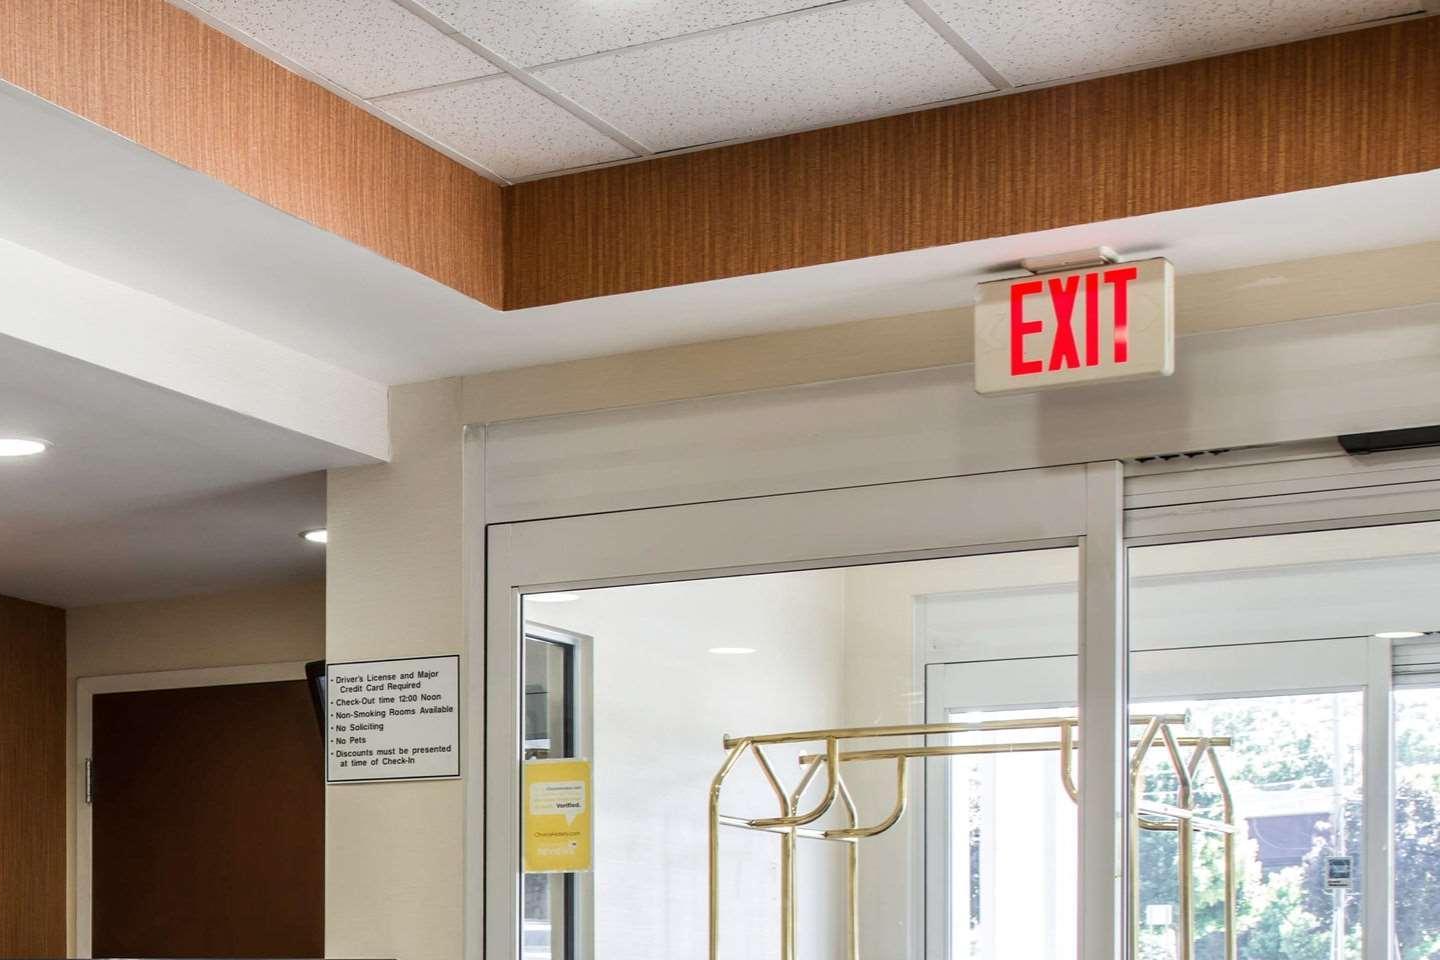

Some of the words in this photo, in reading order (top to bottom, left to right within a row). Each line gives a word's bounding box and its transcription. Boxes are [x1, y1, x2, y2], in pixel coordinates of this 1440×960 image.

[1010, 266, 1138, 377] EXIT
[336, 675, 364, 684] Driver's
[366, 673, 397, 682] License
[399, 671, 414, 680] and
[417, 670, 439, 680] Major
[340, 685, 363, 694] Credit
[366, 683, 385, 692] Card
[387, 681, 421, 692] Required
[336, 696, 376, 707] Check-Out
[378, 695, 395, 704] time
[399, 694, 418, 703] 12:00
[420, 693, 442, 701] Noon
[336, 709, 386, 720] Non-Smoking
[388, 708, 416, 716] Rooms
[419, 705, 454, 715] Available
[336, 724, 347, 732] No
[350, 723, 385, 732] Soliciting
[336, 737, 347, 745] No
[350, 736, 367, 744] Pets
[336, 749, 374, 758] Discounts
[376, 748, 396, 756] must
[398, 747, 409, 755] be
[411, 744, 452, 756] presented
[340, 759, 348, 768] at
[351, 758, 368, 767] time
[370, 757, 379, 766] of
[382, 756, 415, 766] Check-In
